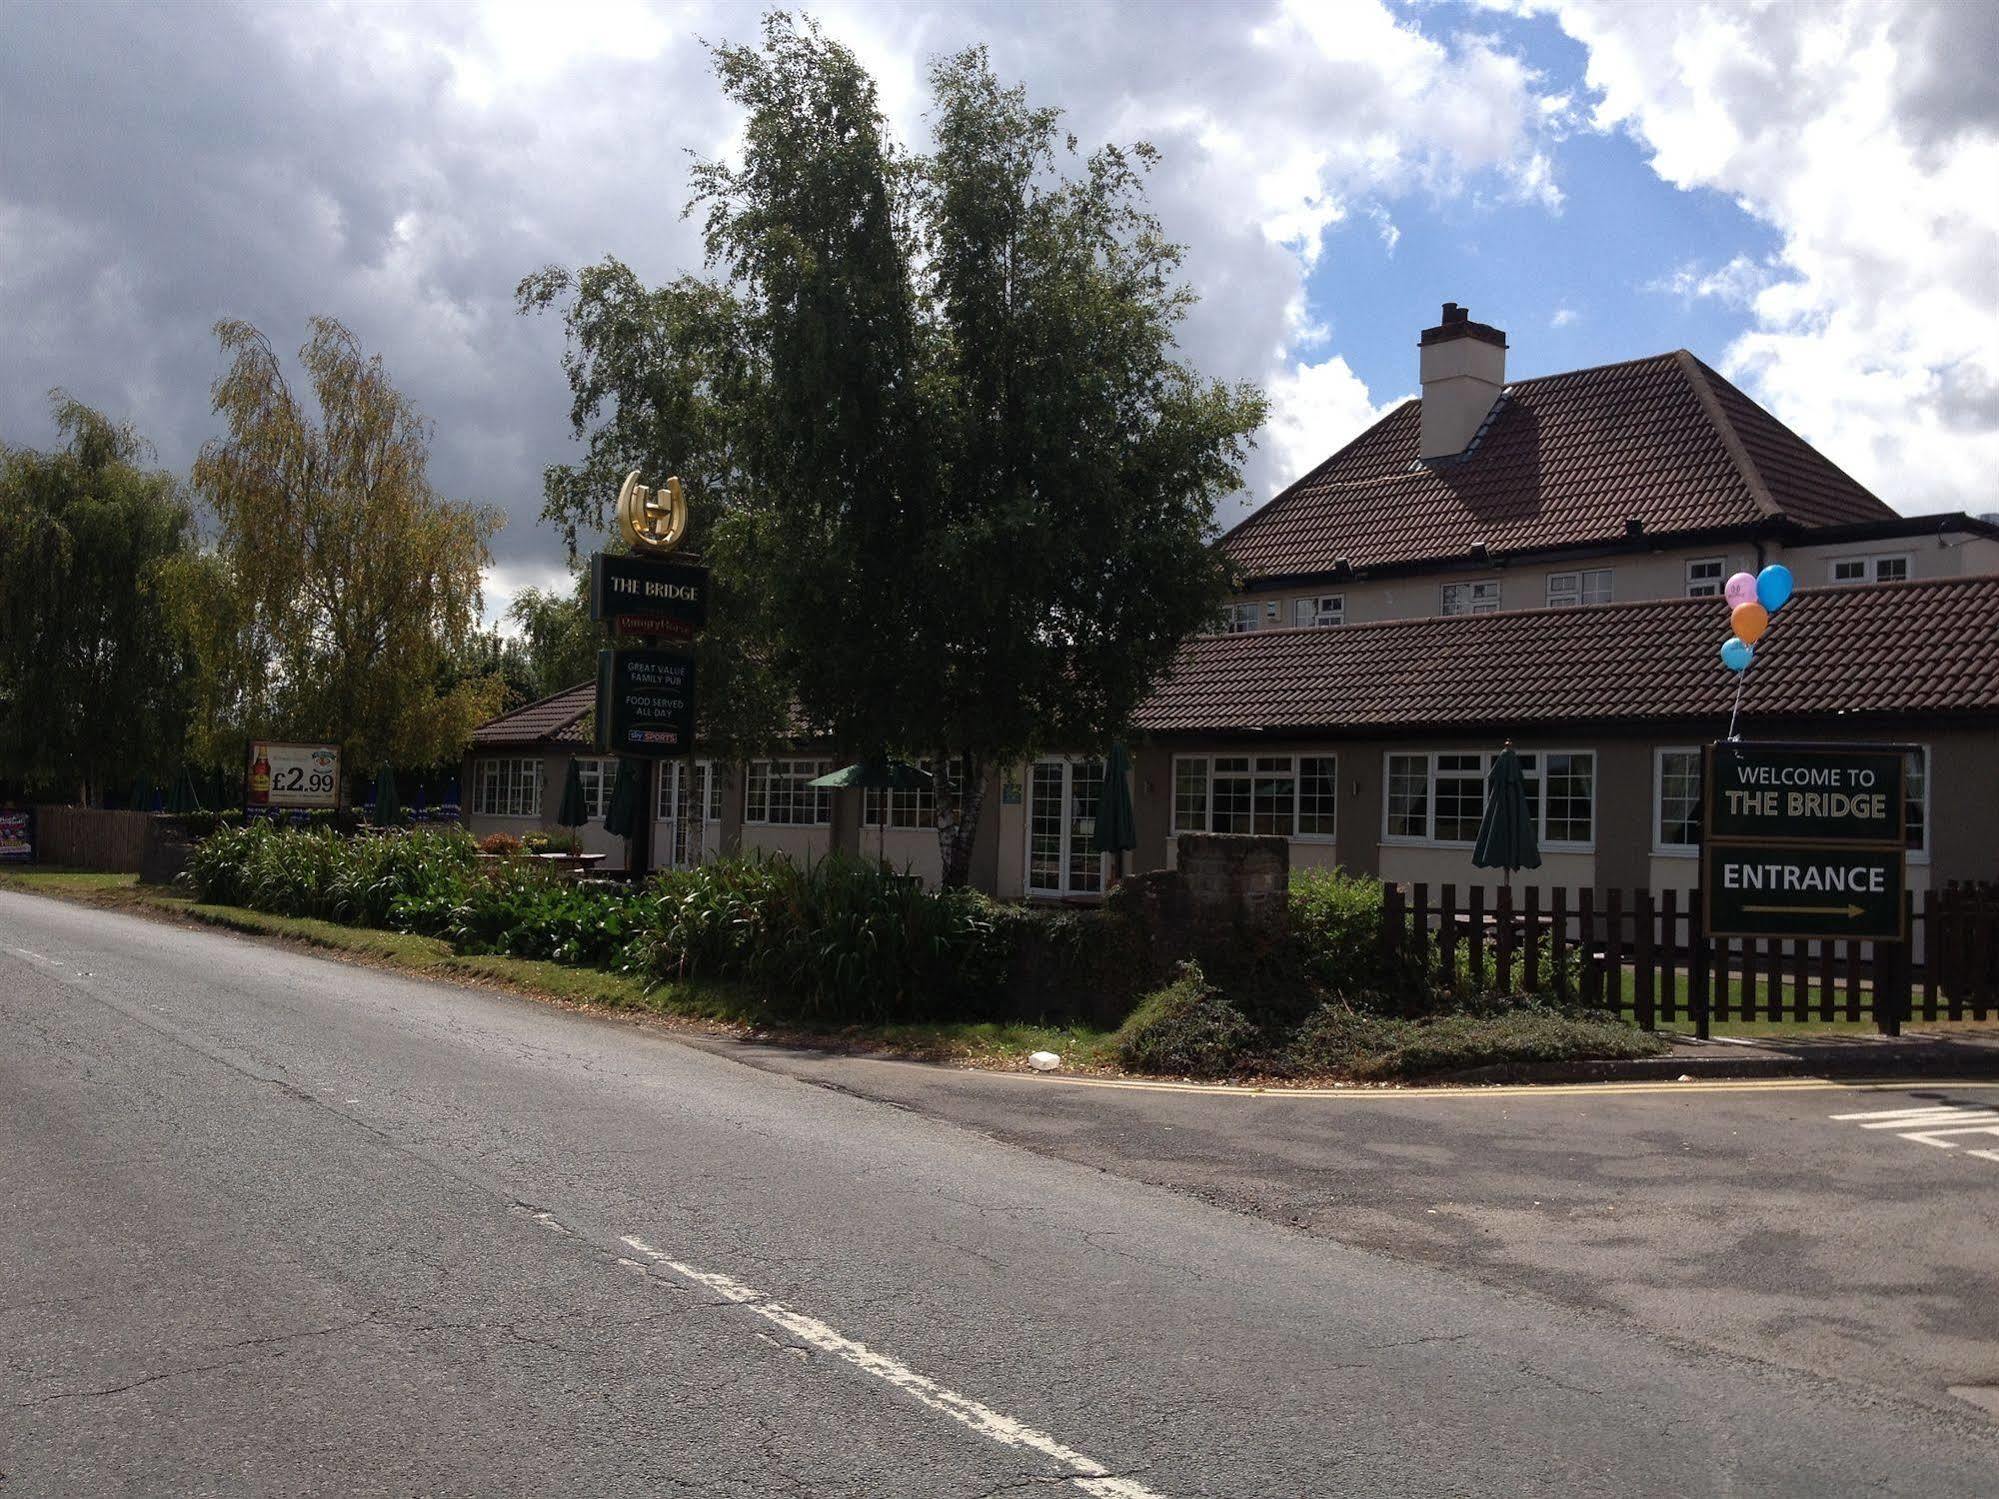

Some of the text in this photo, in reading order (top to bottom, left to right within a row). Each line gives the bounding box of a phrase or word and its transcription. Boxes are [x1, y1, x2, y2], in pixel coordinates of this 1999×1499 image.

[611, 576, 698, 601] THE BRIDGE
[627, 662, 686, 676] GREAT VALUE
[631, 673, 682, 686] FAMILY PUB
[625, 696, 684, 709] FOOD SERVED
[636, 707, 673, 719] ALL DAY
[271, 767, 334, 793] £2.99
[1737, 766, 1876, 788] WELCOME TO
[1725, 790, 1887, 819] THE BRIDGE
[1723, 863, 1886, 892] ENTRANCE
